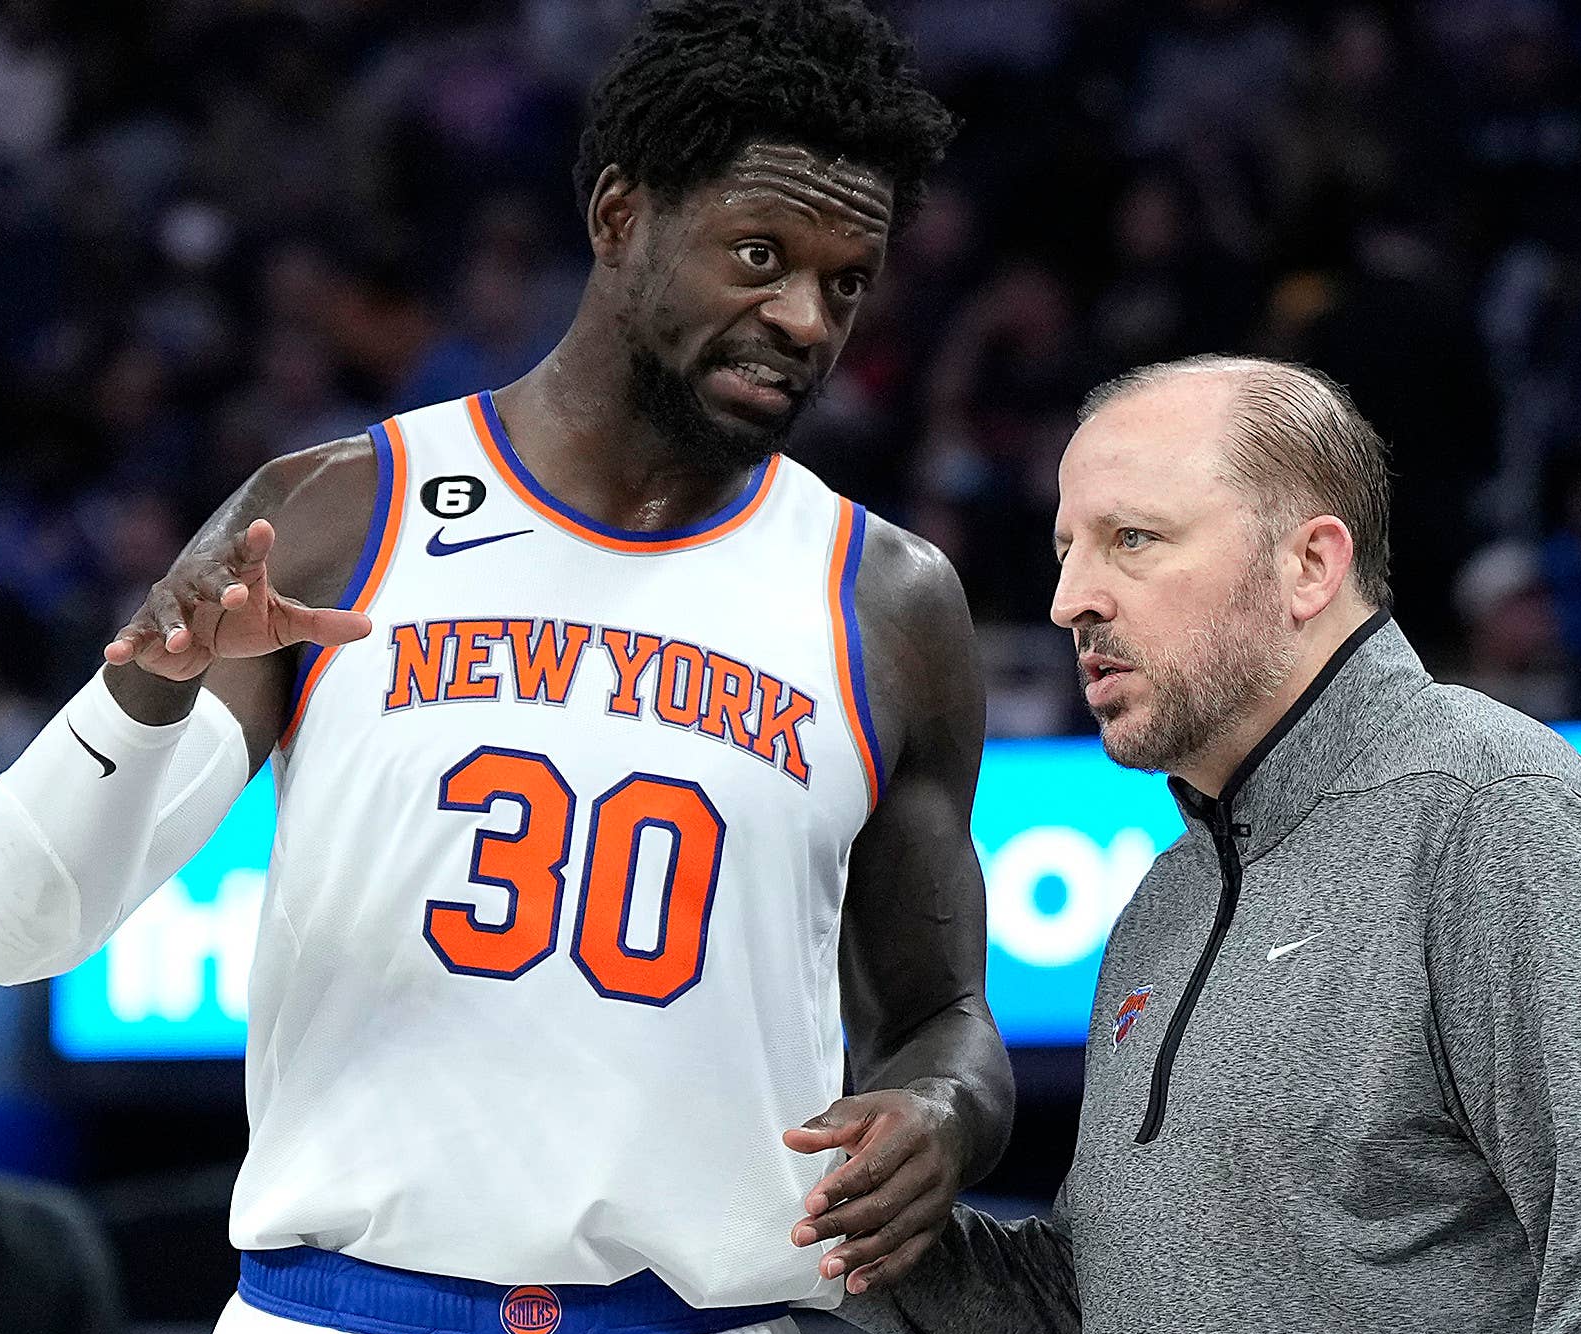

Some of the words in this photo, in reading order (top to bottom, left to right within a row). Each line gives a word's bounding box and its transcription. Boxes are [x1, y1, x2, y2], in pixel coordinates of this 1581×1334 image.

[434, 480, 471, 513] 6
[382, 617, 592, 716] NEW
[598, 622, 817, 790] YORK
[422, 745, 727, 1008] 30
[509, 1300, 554, 1326] KNICKS
